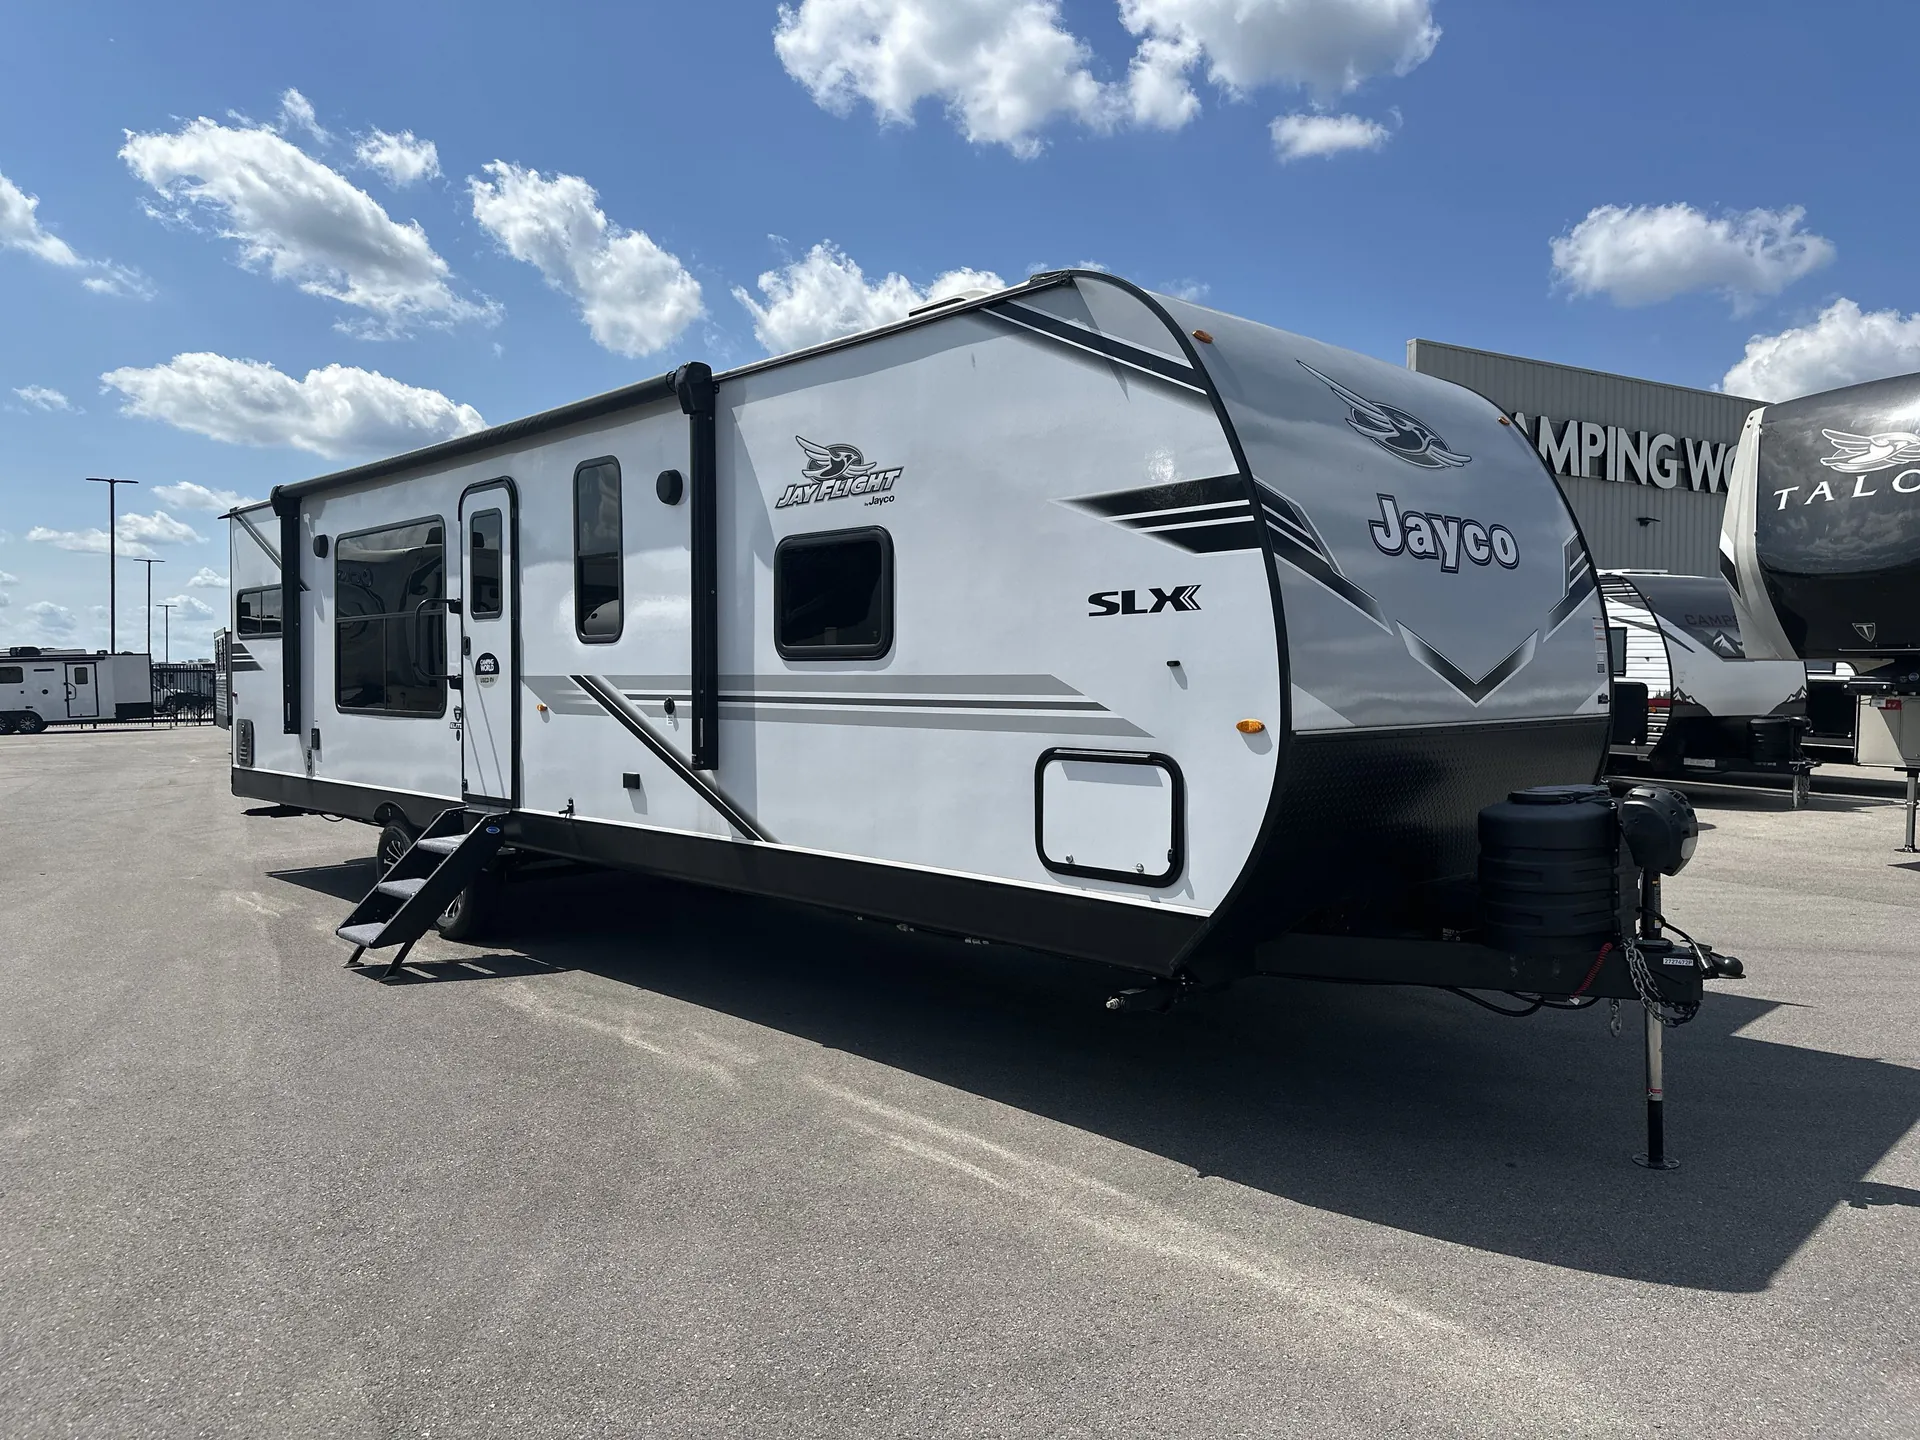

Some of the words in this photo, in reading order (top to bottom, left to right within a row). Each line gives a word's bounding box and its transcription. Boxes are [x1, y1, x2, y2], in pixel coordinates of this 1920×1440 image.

[868, 495, 895, 506] Jayco
[1368, 493, 1520, 574] Jayco
[1088, 584, 1202, 617] SLX
[1684, 614, 1738, 627] CAMP
